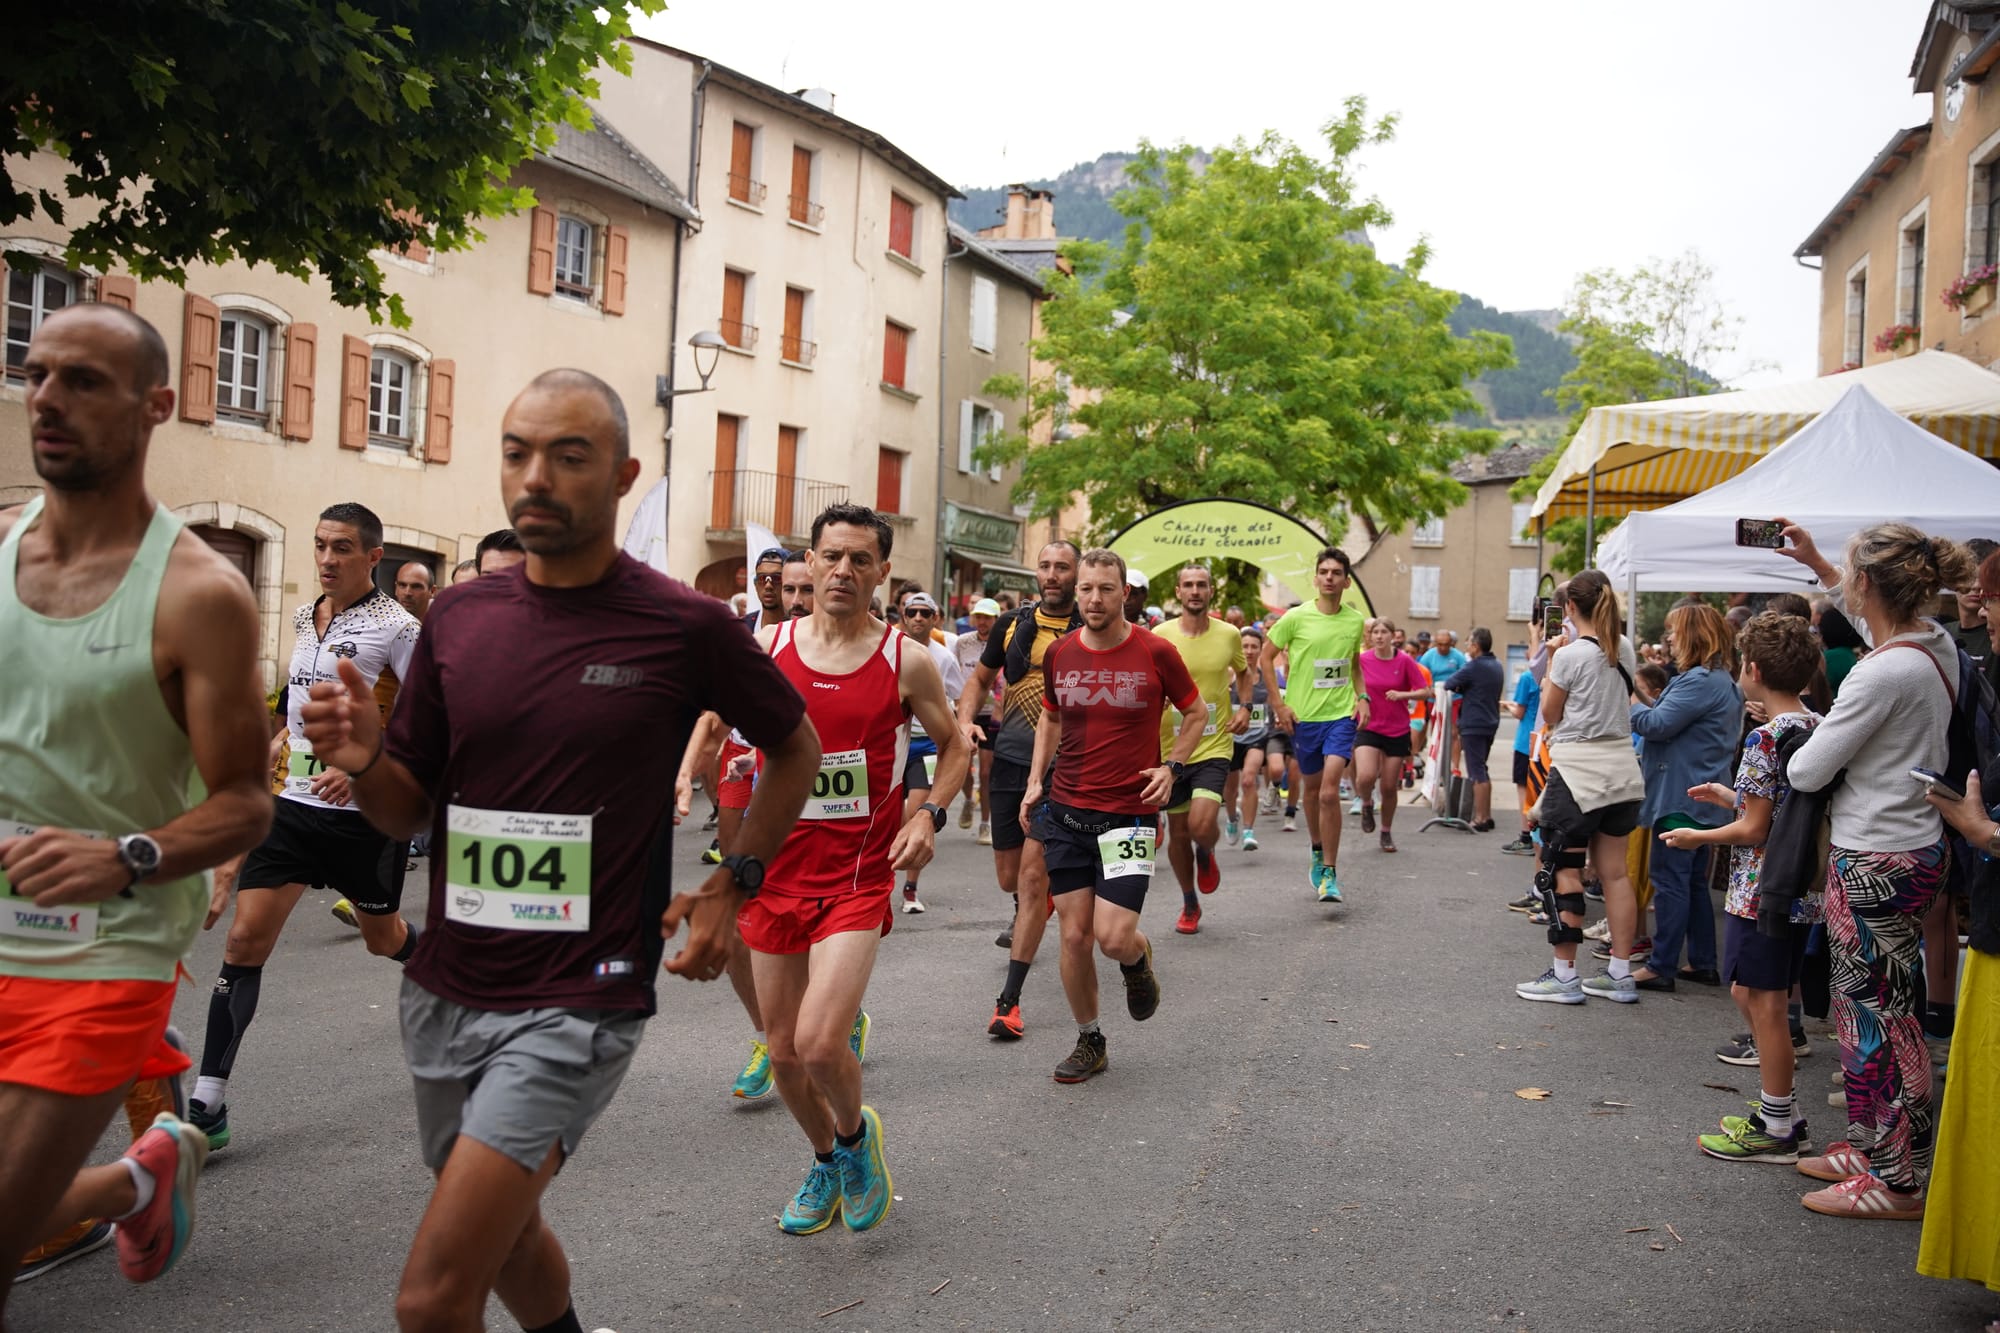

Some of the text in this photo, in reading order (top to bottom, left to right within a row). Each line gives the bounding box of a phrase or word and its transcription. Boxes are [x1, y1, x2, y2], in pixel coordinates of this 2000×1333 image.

[1163, 520, 1272, 537] Challenge des
[1153, 534, 1282, 547] vallées cévenoles
[1055, 668, 1148, 686] LOZÈRE
[1324, 666, 1341, 679] 21
[290, 676, 312, 686] LEY
[812, 681, 836, 690] CRAFT
[1054, 686, 1148, 709] TRAIL
[822, 803, 851, 811] TUFF'S
[1117, 840, 1147, 860] 35
[463, 840, 567, 891] 104
[510, 903, 557, 915] TUFF'S
